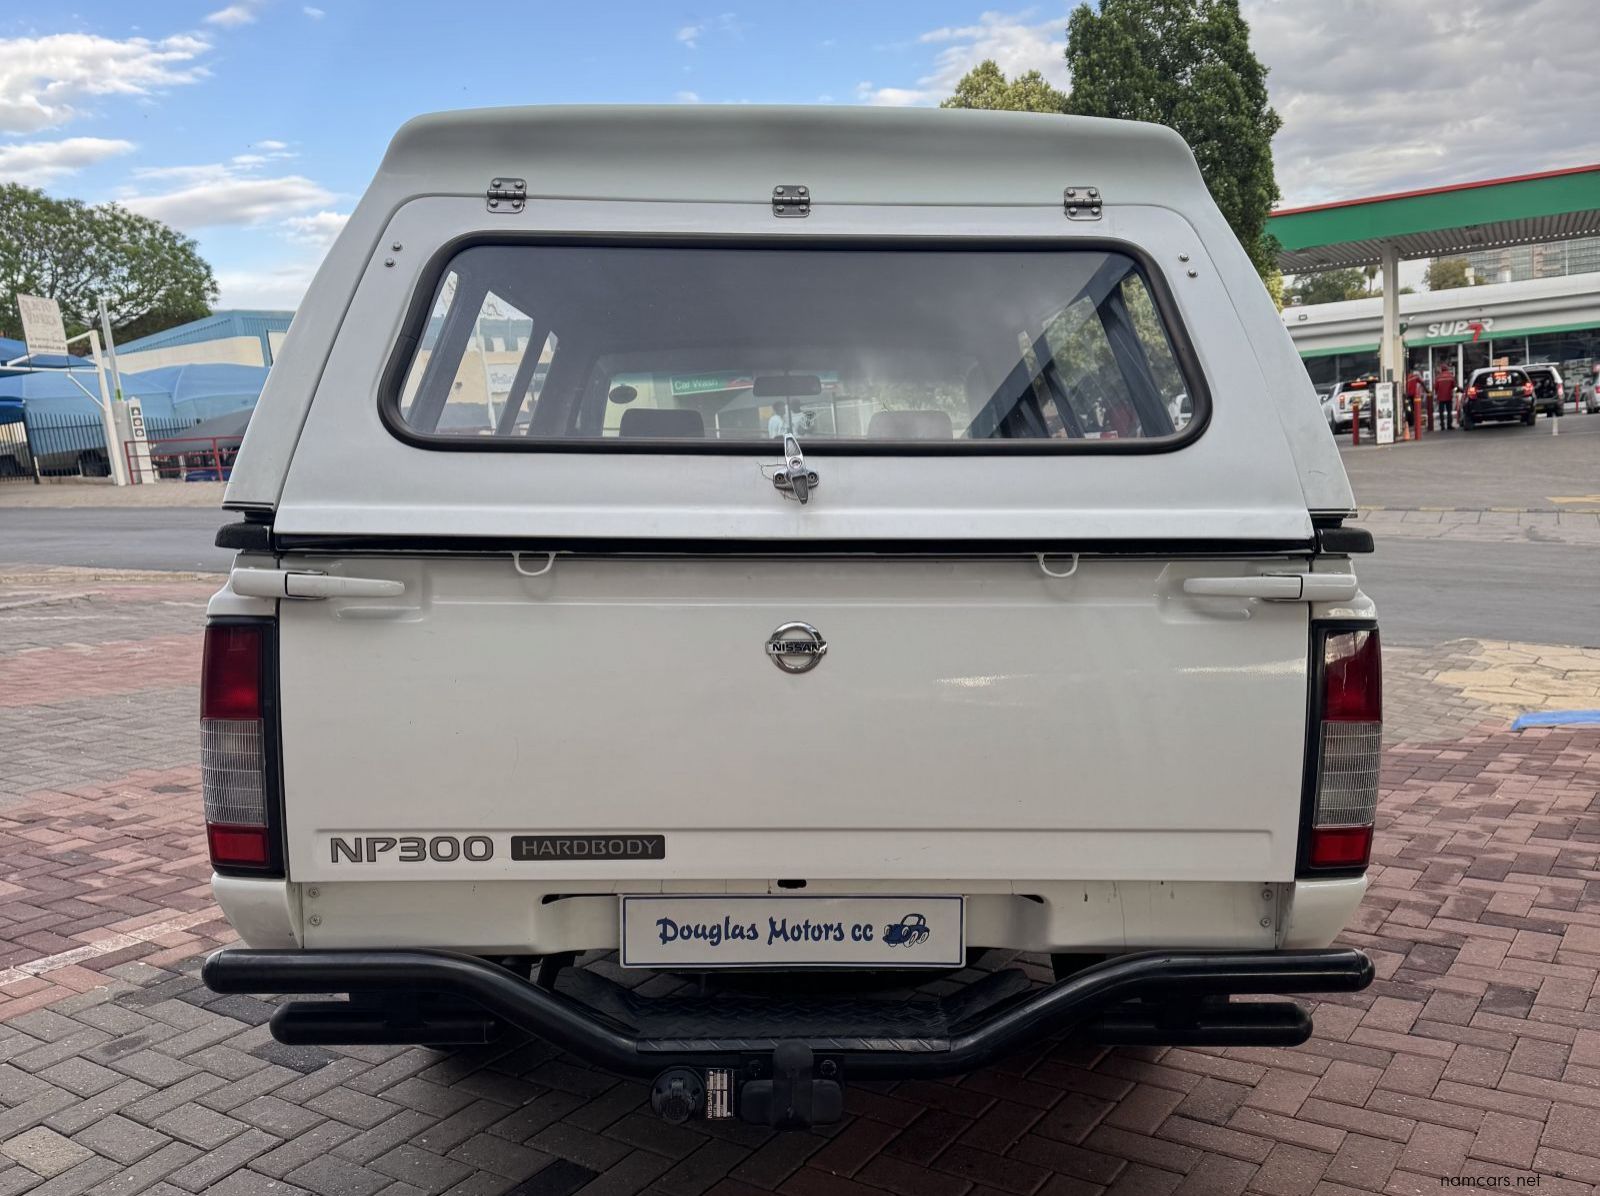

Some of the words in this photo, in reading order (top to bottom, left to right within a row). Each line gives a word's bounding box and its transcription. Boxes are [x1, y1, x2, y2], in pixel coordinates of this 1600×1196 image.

[674, 380, 690, 390] Car
[772, 642, 820, 652] NISSAN
[330, 836, 493, 863] NP300
[521, 838, 657, 856] HARDBODY
[656, 915, 759, 946] Douglas
[767, 916, 845, 946] Motors
[851, 923, 873, 942] cc
